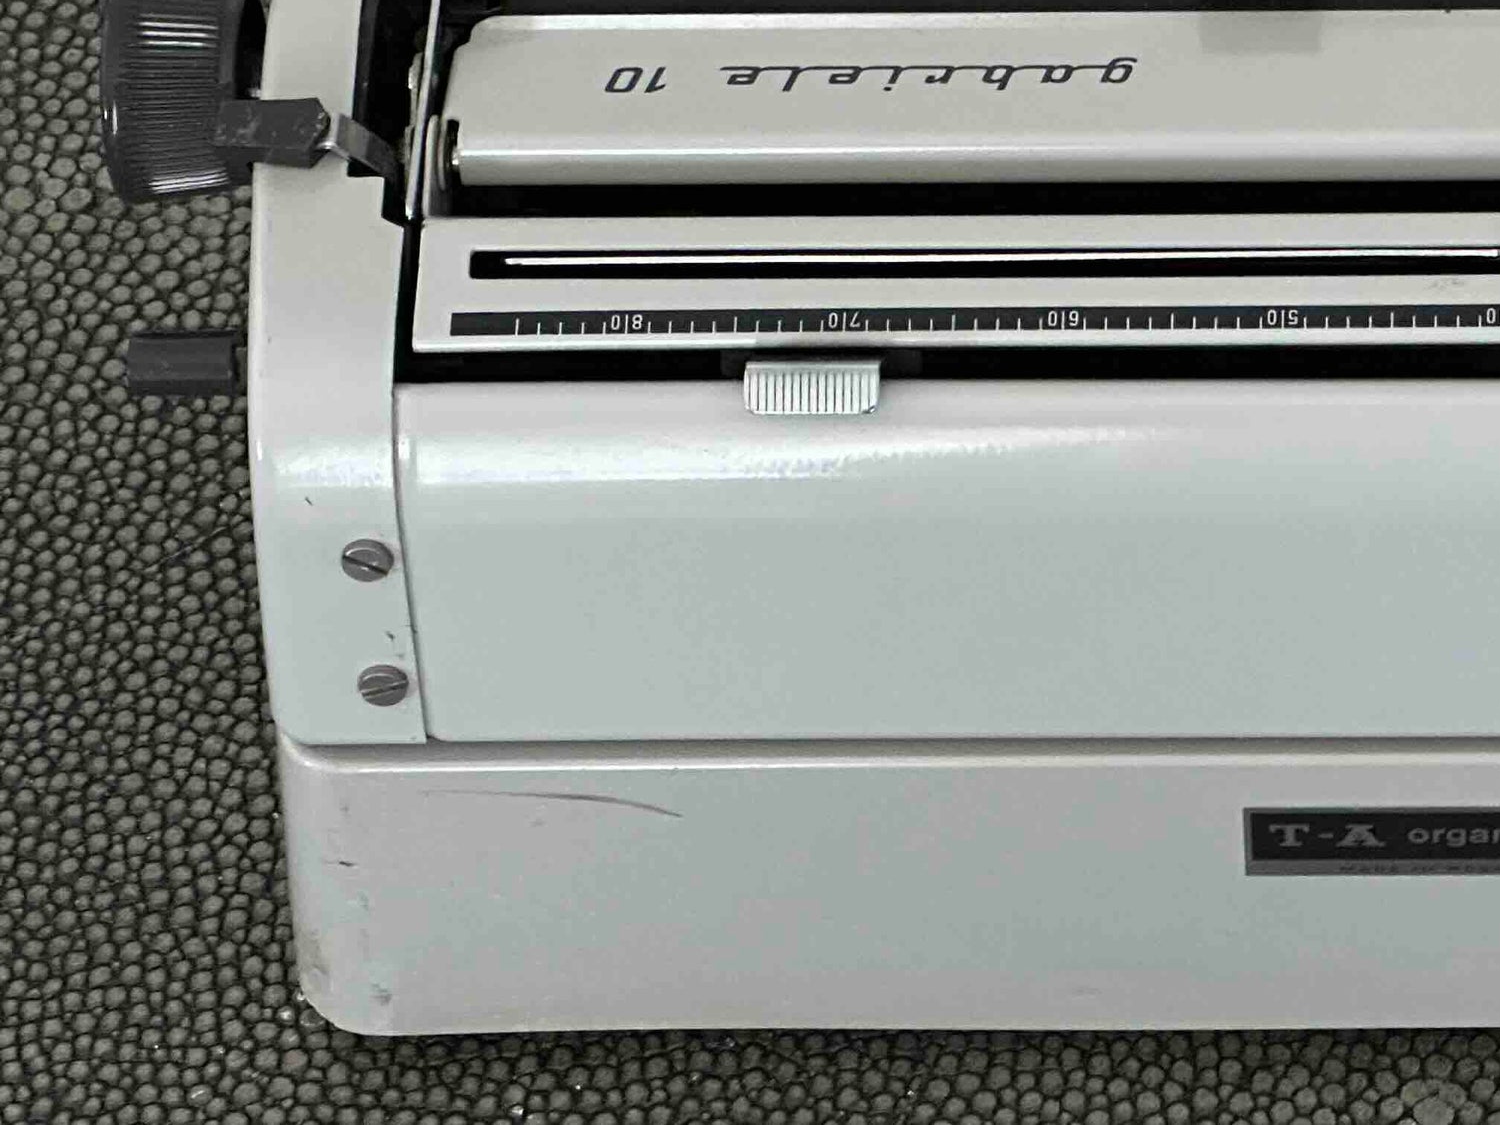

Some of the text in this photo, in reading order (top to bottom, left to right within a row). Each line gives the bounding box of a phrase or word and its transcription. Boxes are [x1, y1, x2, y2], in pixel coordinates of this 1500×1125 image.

[604, 56, 1138, 94] gabriele 10
[610, 314, 644, 331] 80
[827, 312, 861, 329] 70
[1047, 310, 1080, 327] 60
[1267, 309, 1299, 326] 50
[1268, 822, 1387, 848] T-A
